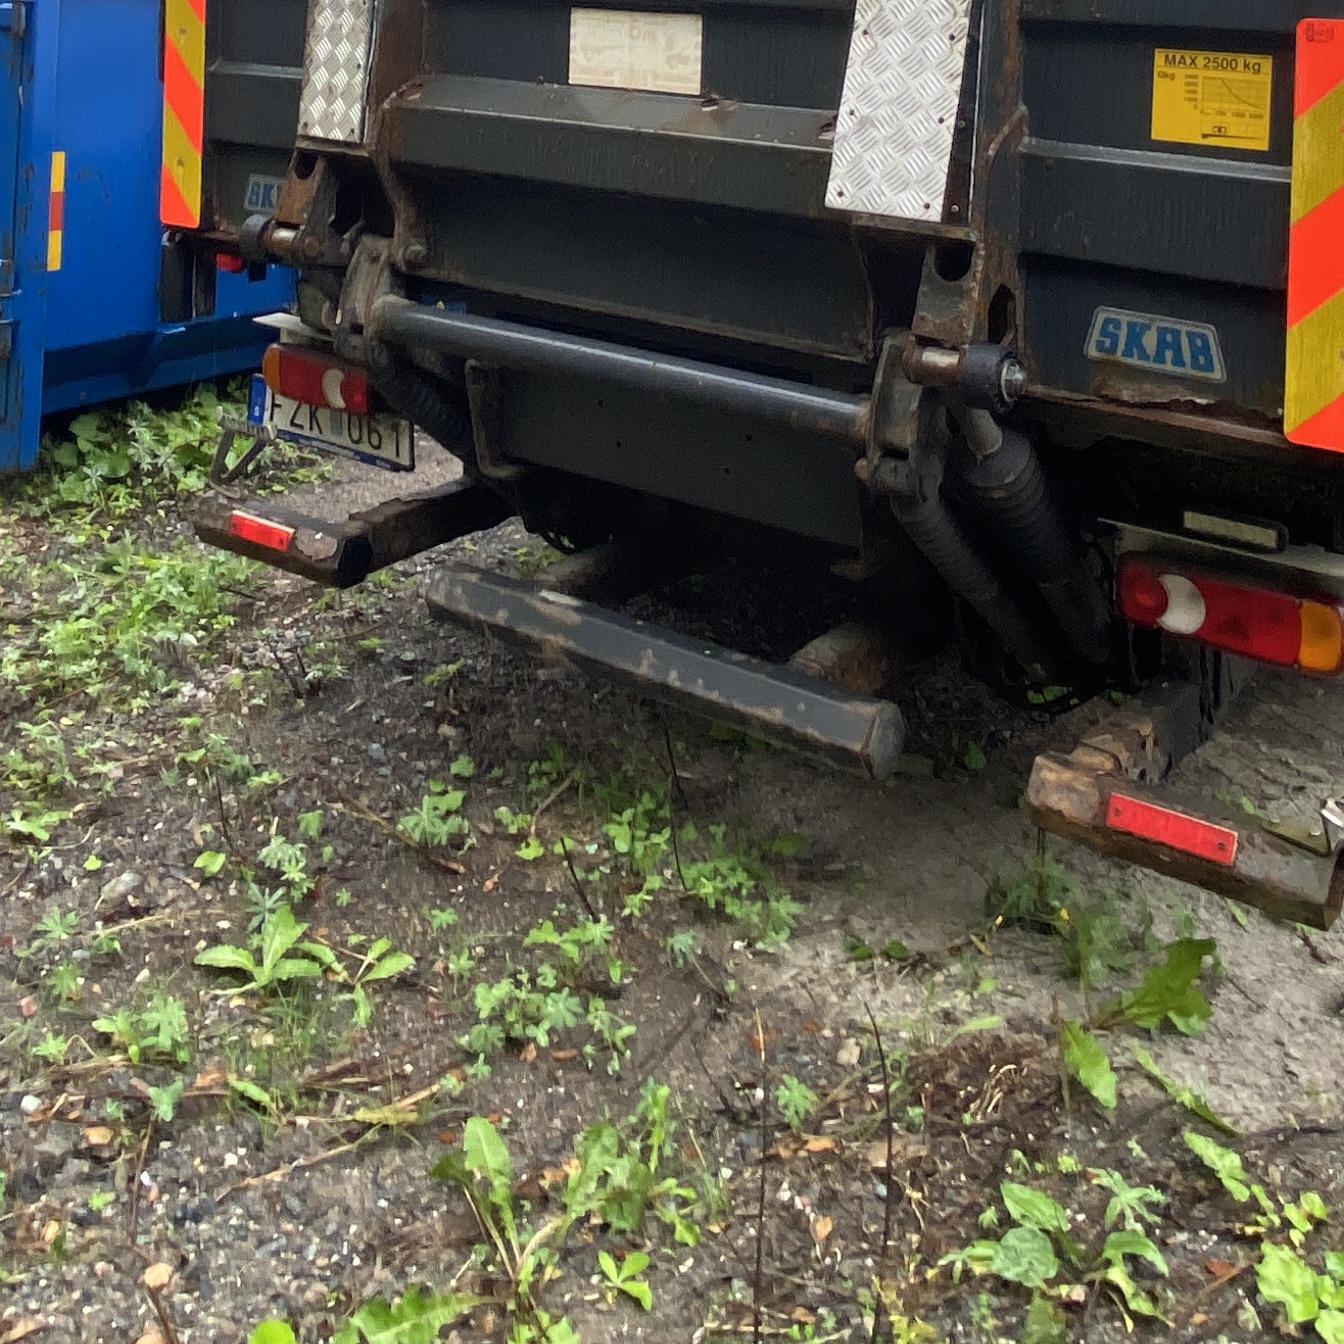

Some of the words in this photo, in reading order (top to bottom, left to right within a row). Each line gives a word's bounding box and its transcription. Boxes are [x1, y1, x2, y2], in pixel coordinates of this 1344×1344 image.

[1164, 53, 1199, 69] MAX
[1203, 56, 1239, 71] 2500
[1242, 58, 1262, 75] kg
[1095, 316, 1216, 373] SKAB
[347, 413, 400, 458] 061
